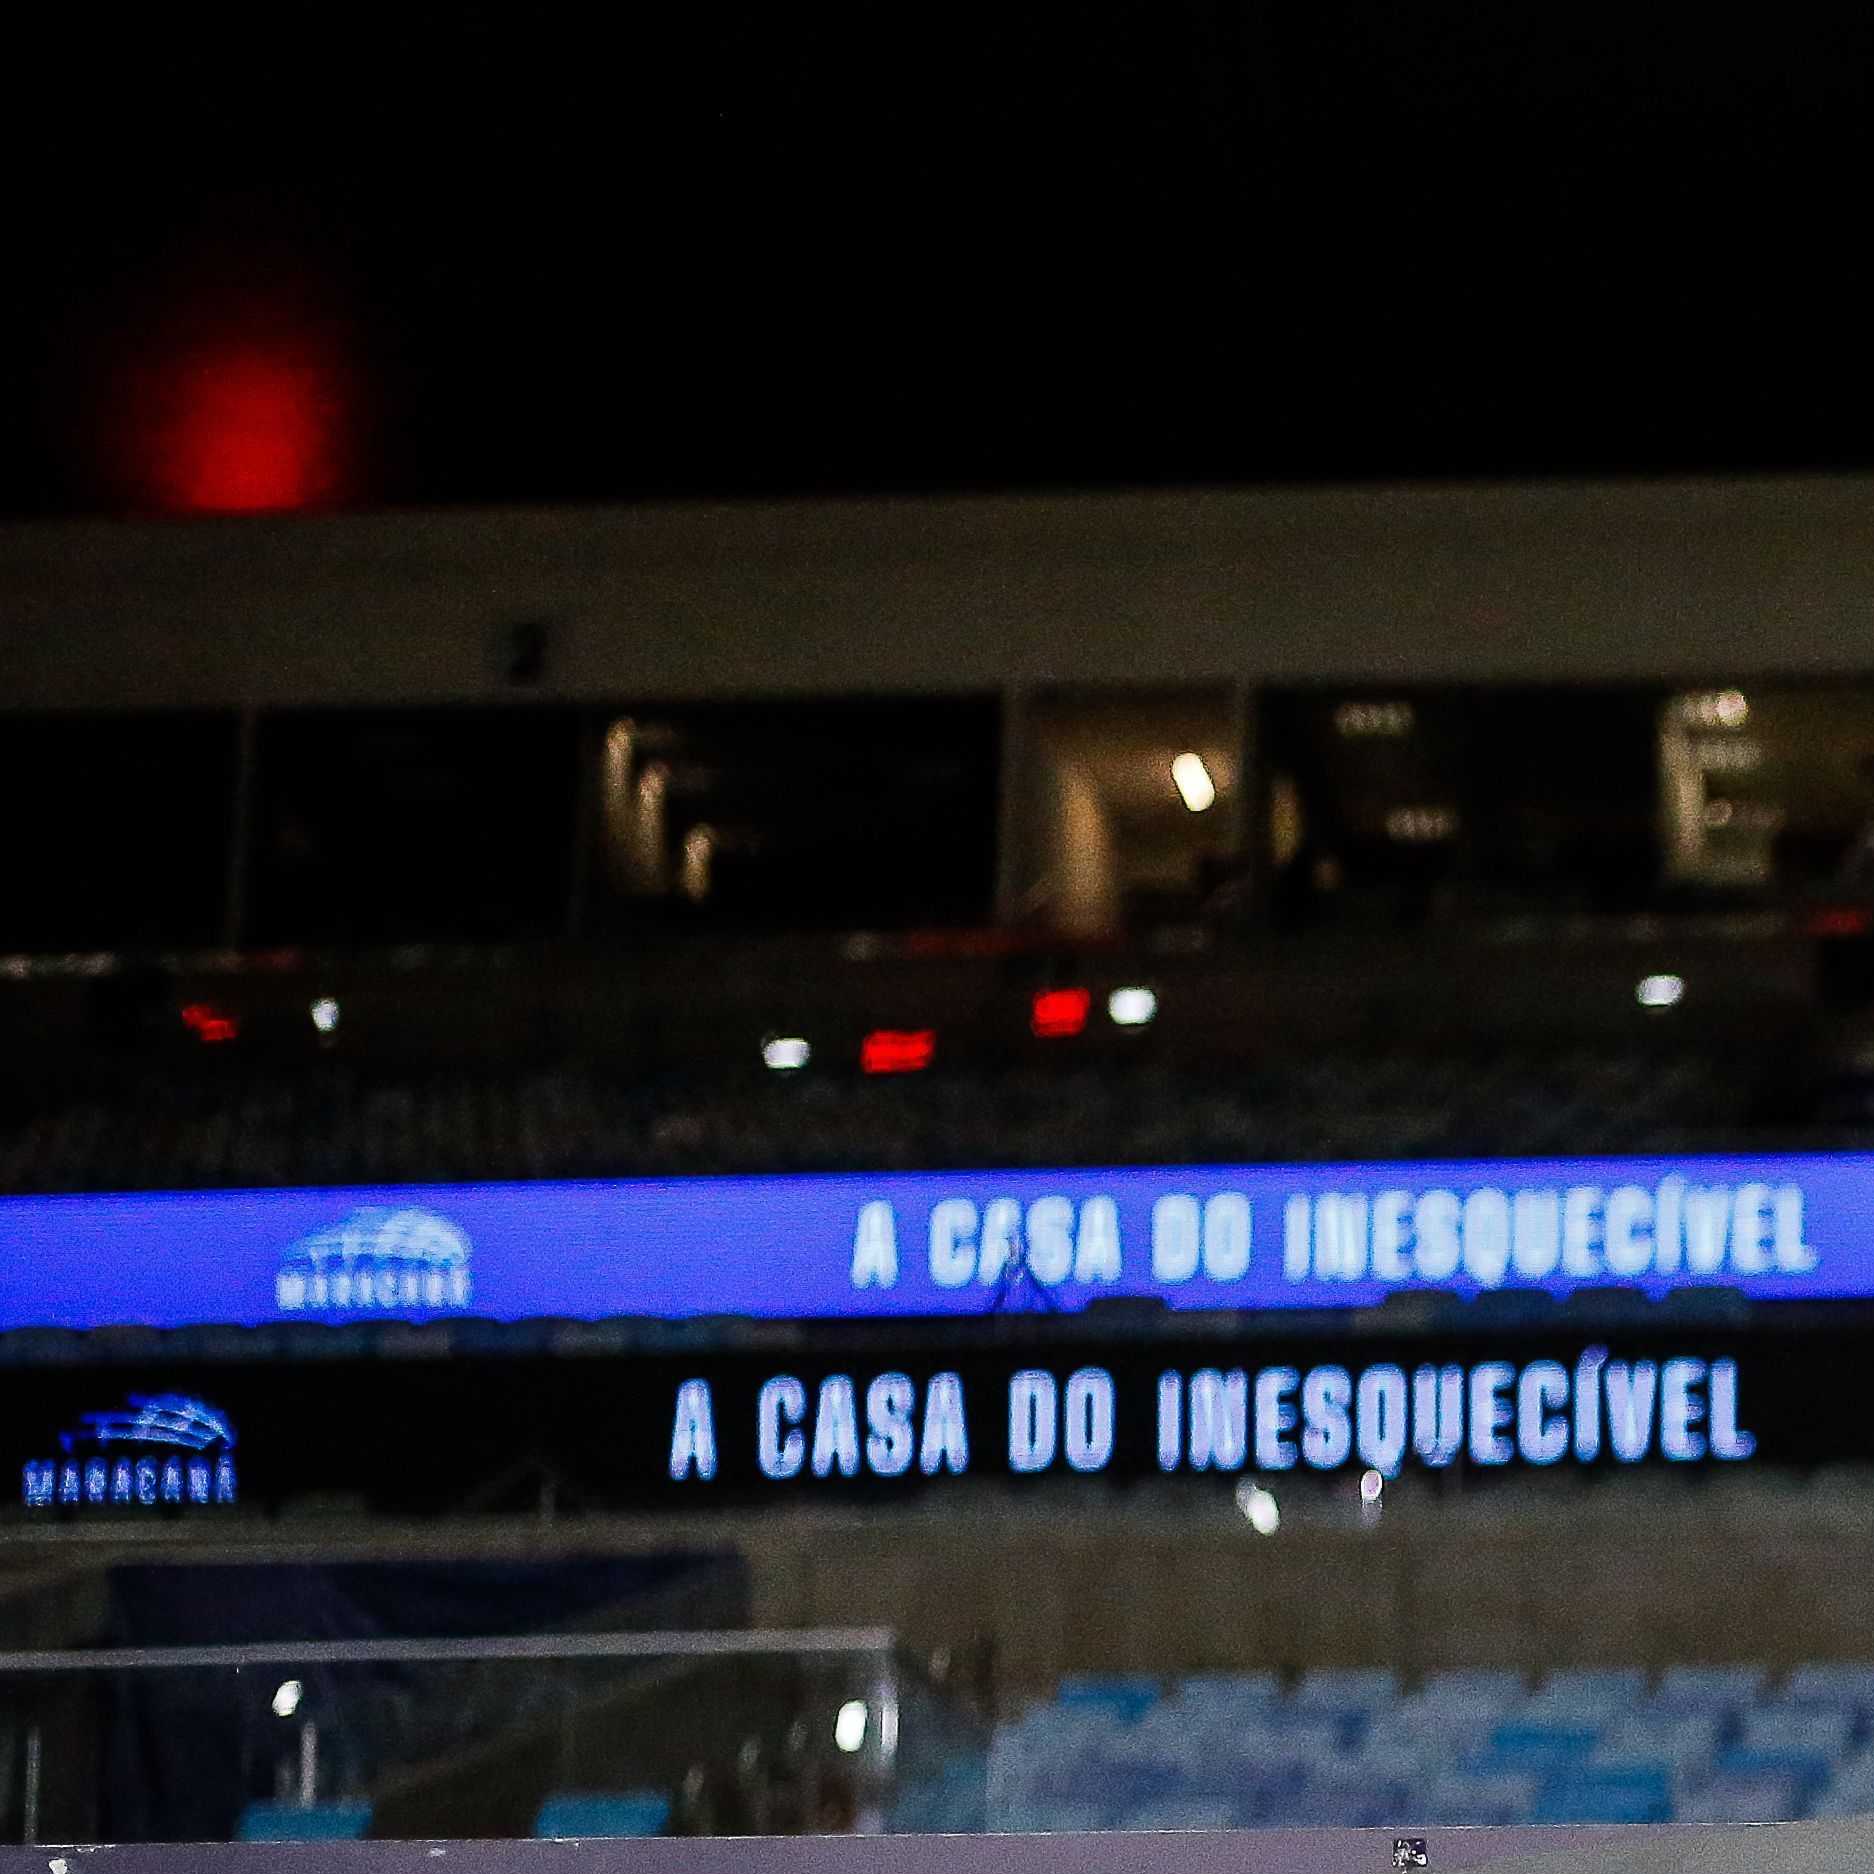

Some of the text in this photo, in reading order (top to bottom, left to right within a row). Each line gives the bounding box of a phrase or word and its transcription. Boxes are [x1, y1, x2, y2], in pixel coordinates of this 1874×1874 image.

[850, 1174, 1817, 1289] A CASA DO INESQUECÍVEL
[668, 1345, 1756, 1480] A CASA DO INESQUECÍVEL
